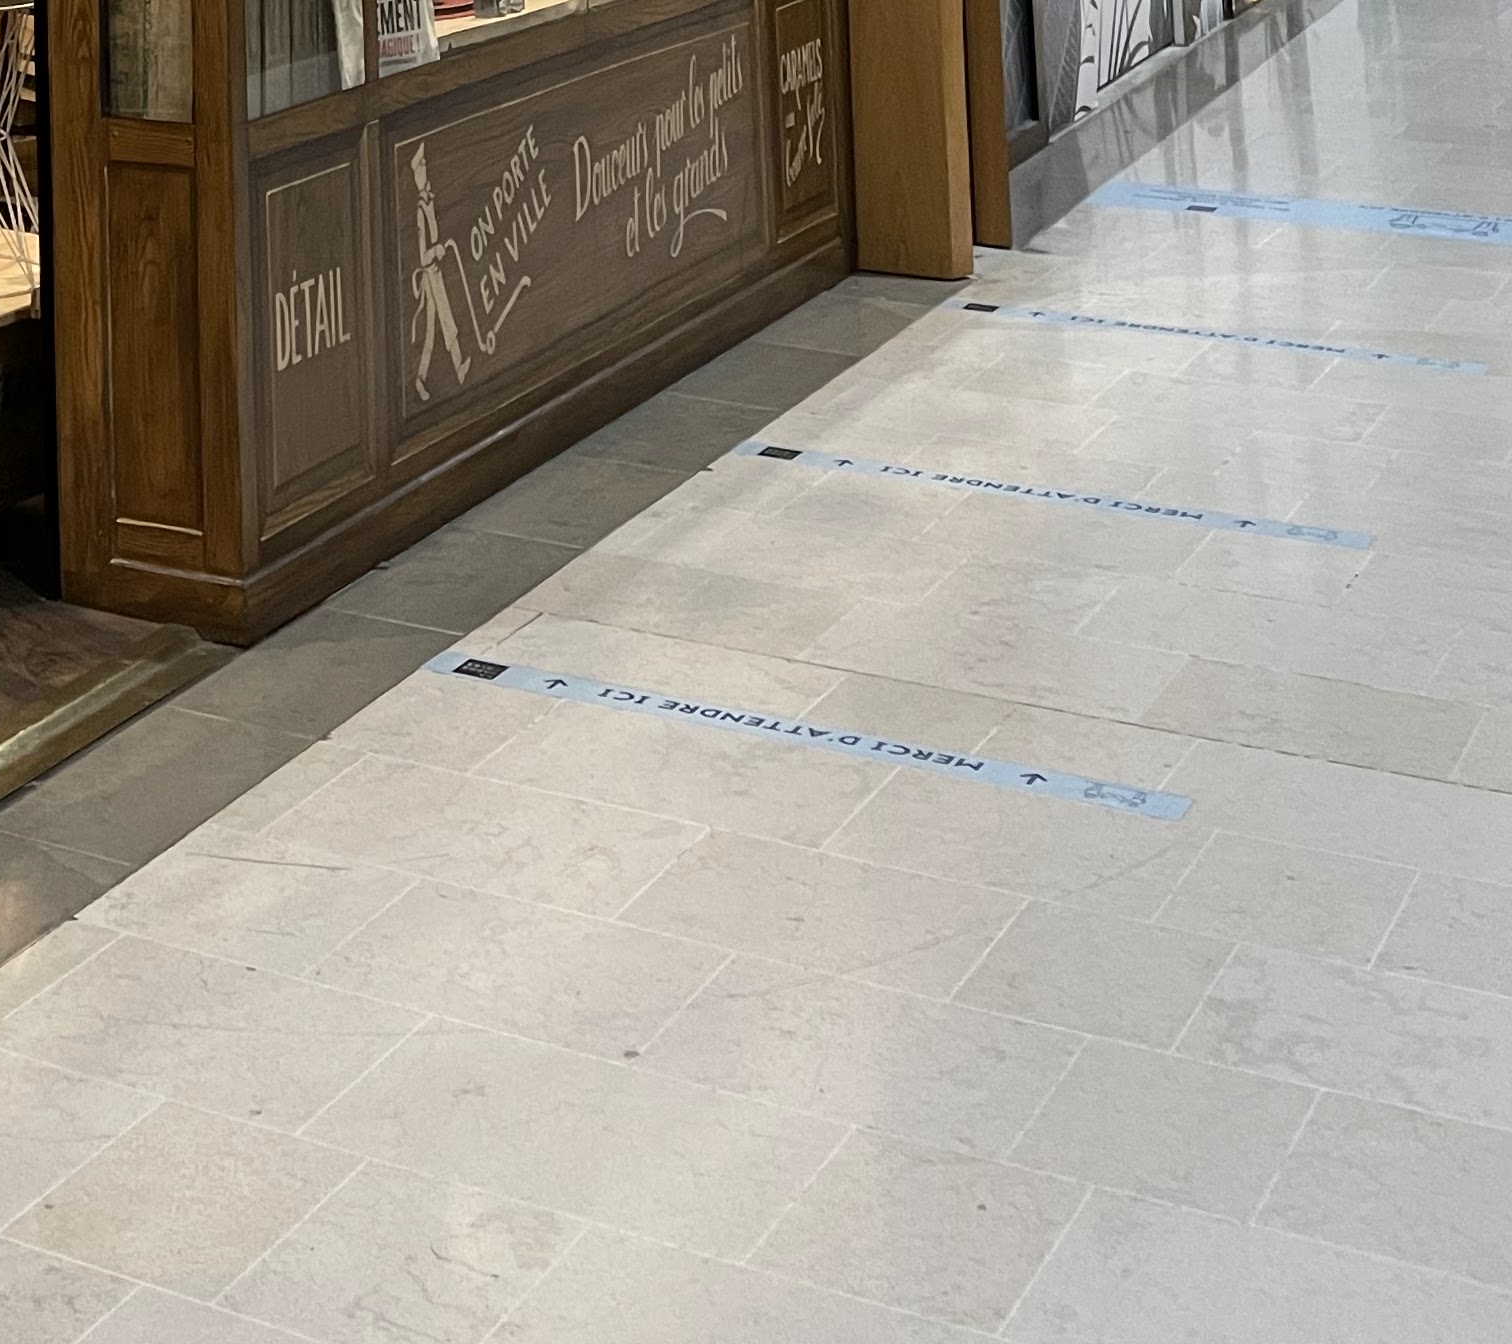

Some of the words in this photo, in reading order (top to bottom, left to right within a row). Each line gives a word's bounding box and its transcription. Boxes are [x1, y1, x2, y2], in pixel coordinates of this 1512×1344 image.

[379, 36, 415, 58] AGIQUE
[573, 122, 649, 222] Douceurs
[655, 91, 687, 178] pour
[689, 54, 706, 129] les
[709, 34, 743, 140] petits
[470, 207, 495, 261] ON
[492, 124, 540, 221] PORTE
[626, 184, 641, 259] et
[645, 167, 667, 239] les
[670, 117, 729, 258] grands
[479, 251, 506, 315] EN
[504, 168, 553, 263] VILLE
[275, 267, 352, 371] DÉTAIL
[879, 465, 924, 478] ICI
[931, 473, 1102, 505] D'ATTENDRE
[1109, 500, 1204, 521] MERCI
[597, 687, 651, 706] ICI
[657, 699, 862, 748] D'ATTENDRE
[870, 740, 985, 772] MERCI
